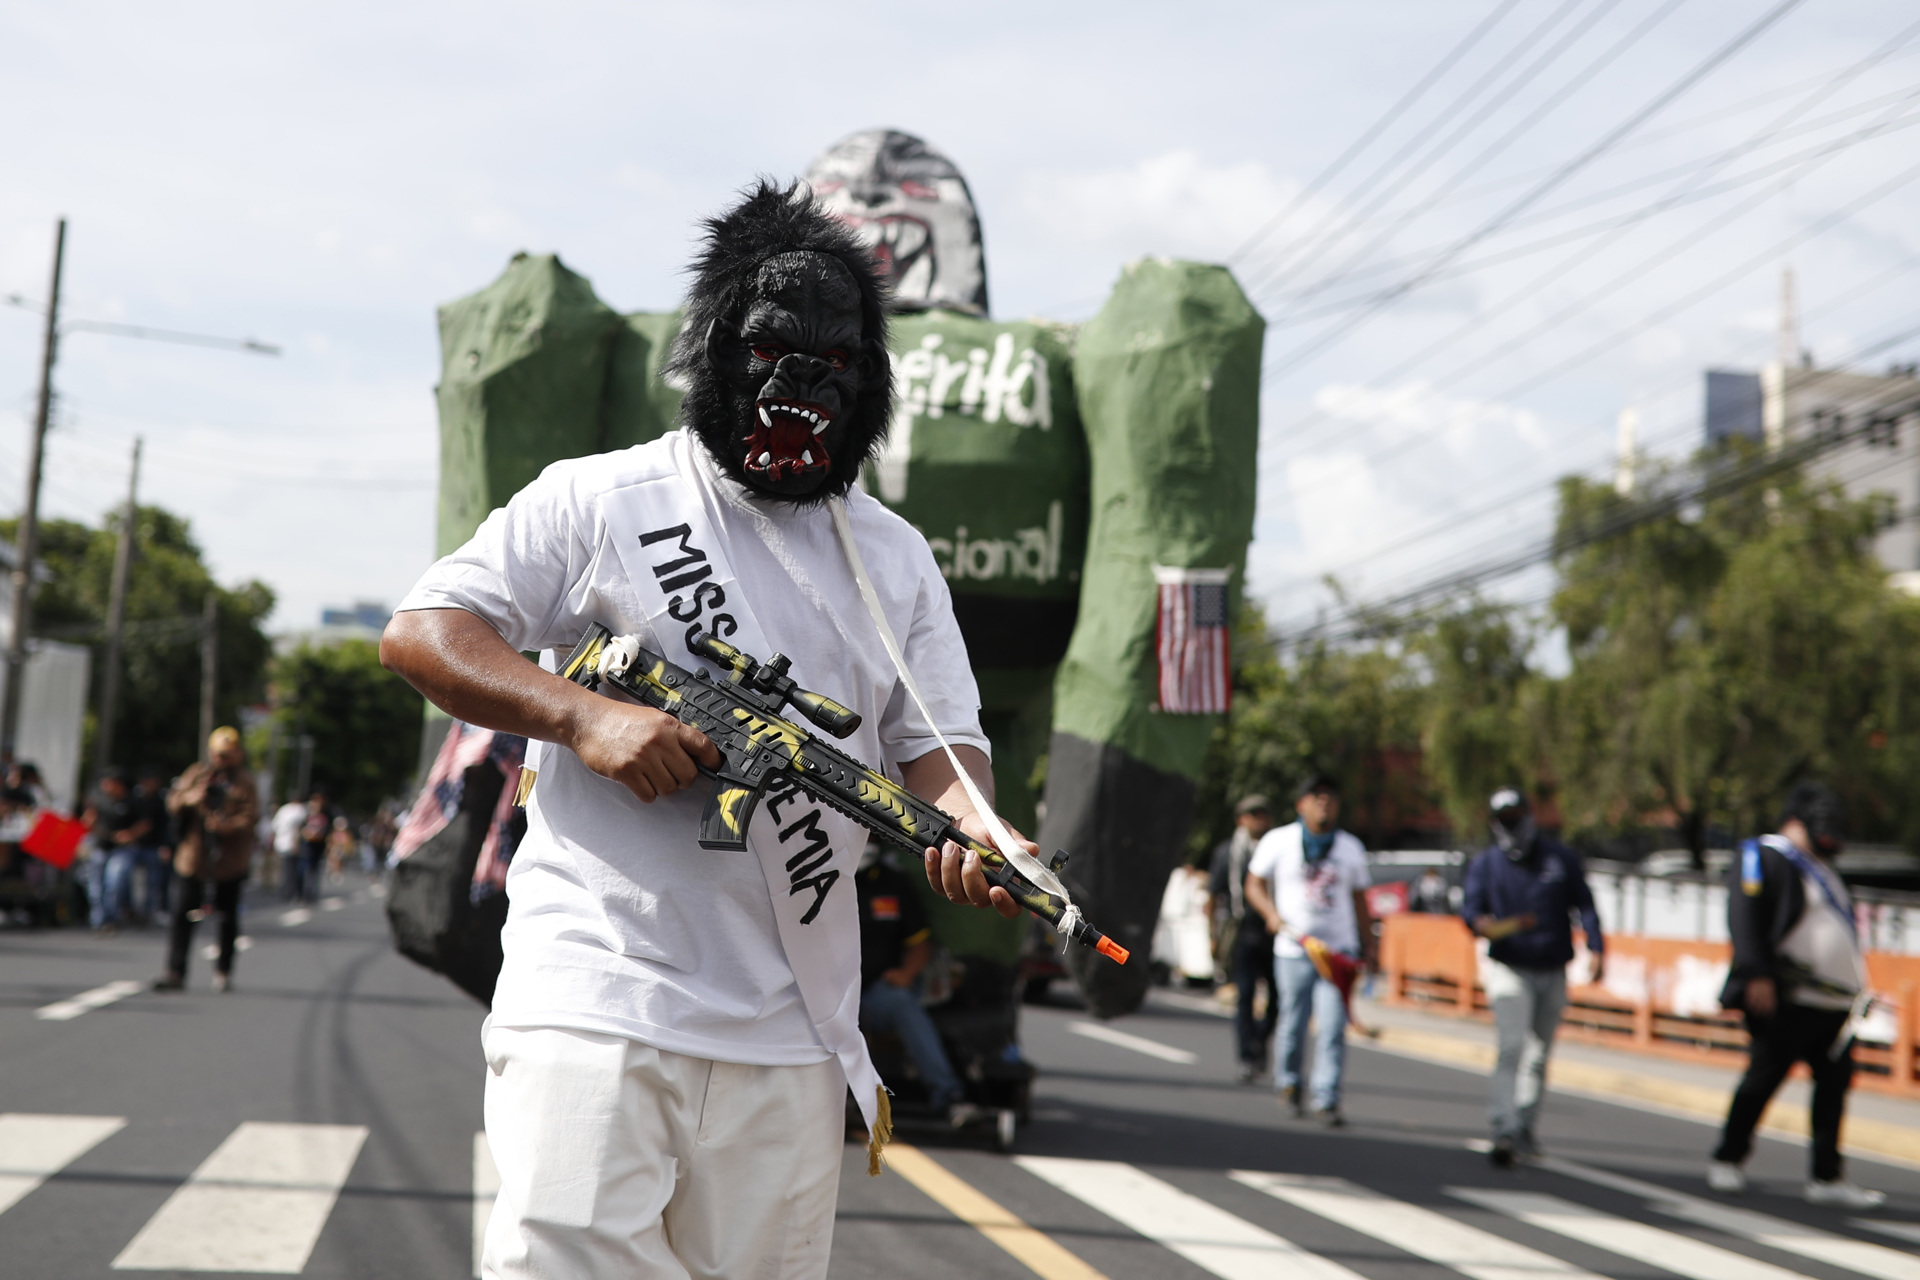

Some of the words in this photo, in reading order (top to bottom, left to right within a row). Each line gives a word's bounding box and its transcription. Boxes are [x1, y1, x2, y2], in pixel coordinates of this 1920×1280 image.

[889, 333, 1053, 431] érita
[638, 523, 738, 656] MISS
[914, 500, 1063, 585] cional
